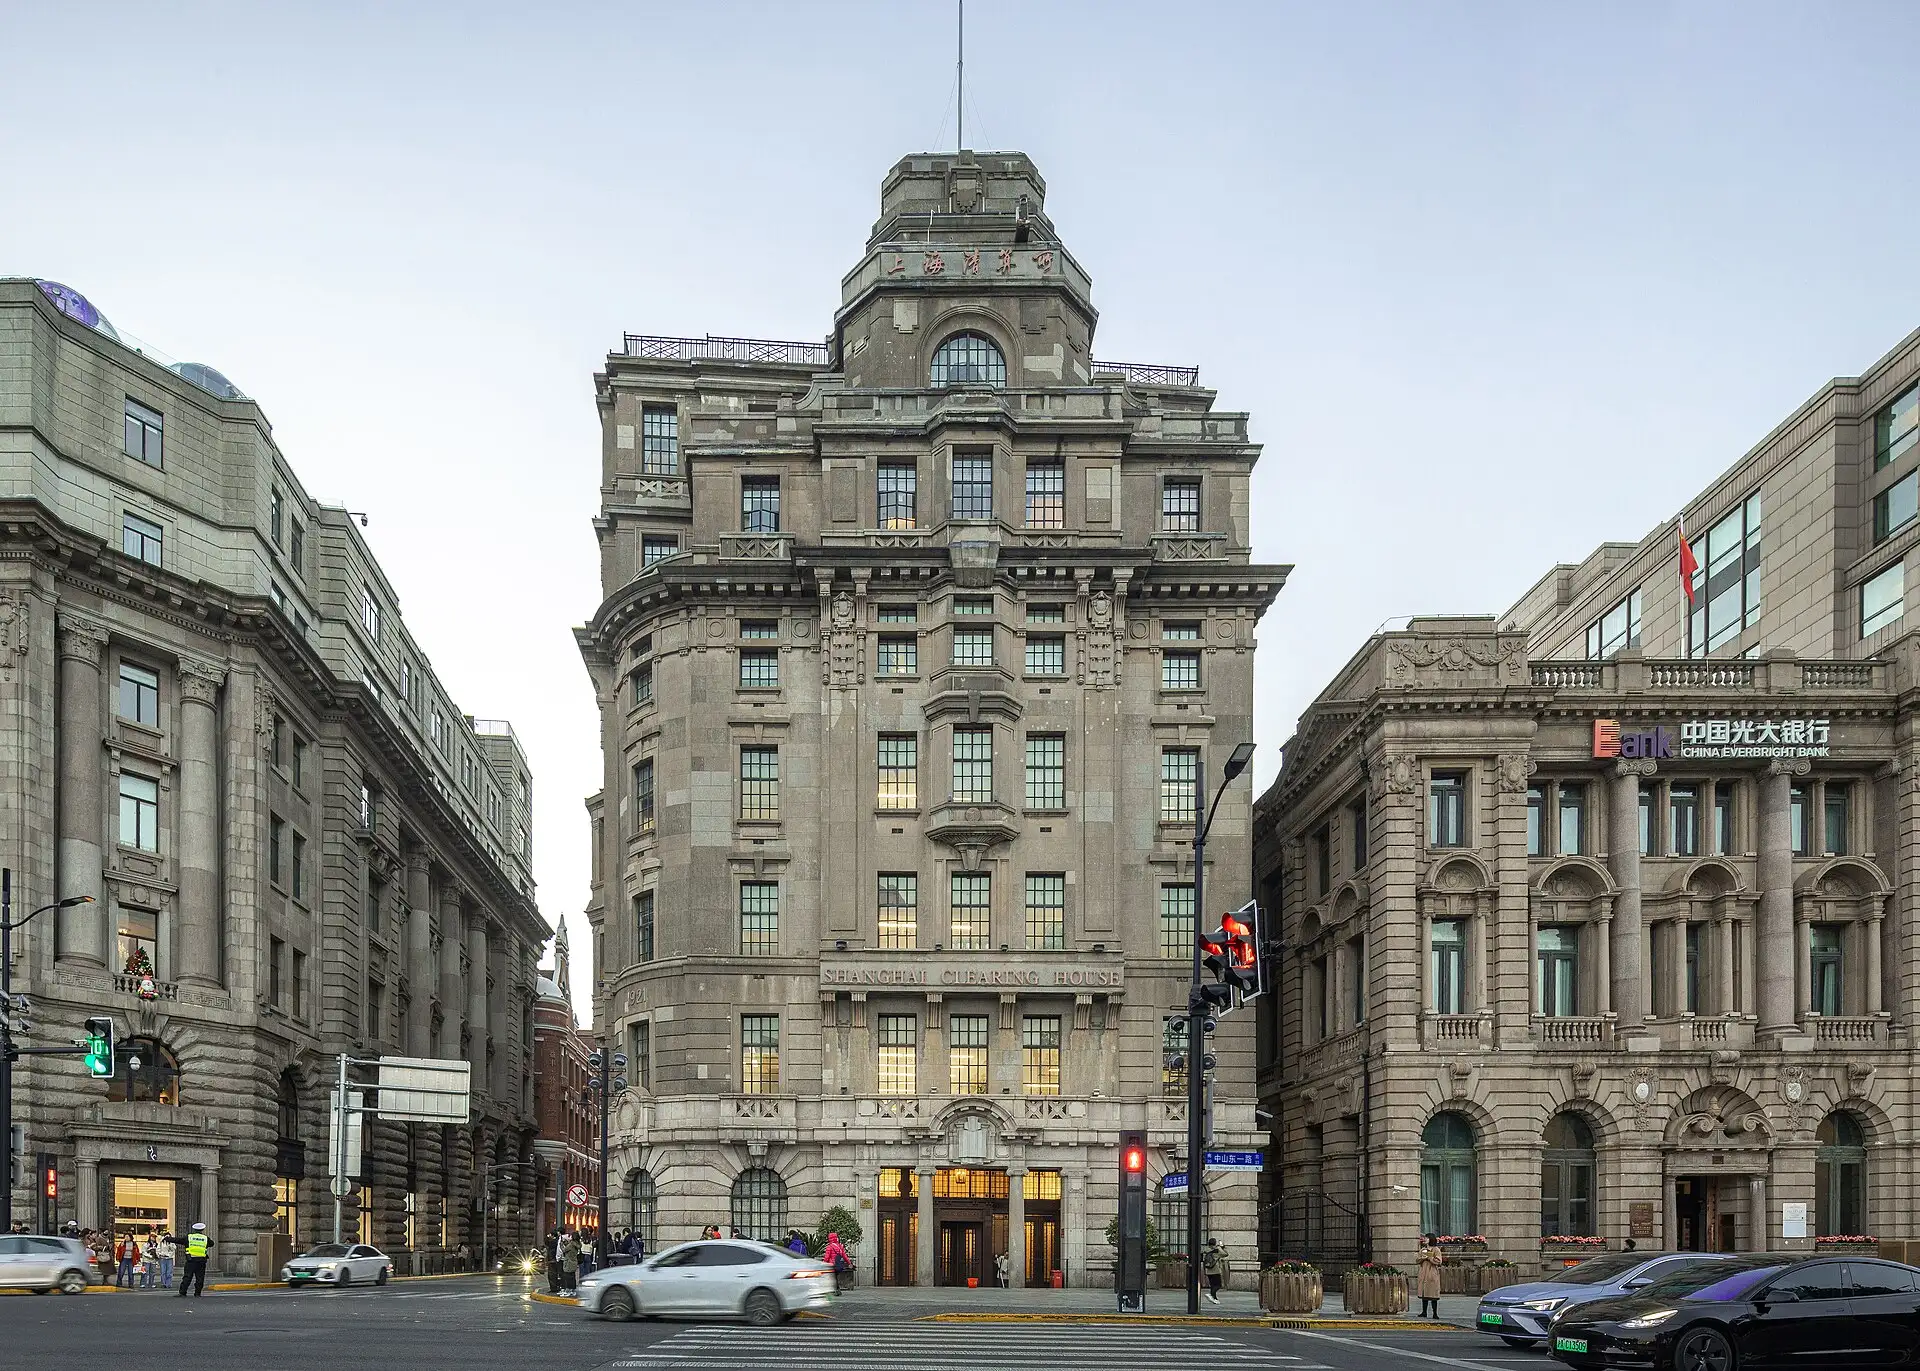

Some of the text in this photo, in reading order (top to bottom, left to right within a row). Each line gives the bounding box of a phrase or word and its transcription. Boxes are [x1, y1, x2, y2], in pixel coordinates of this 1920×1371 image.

[887, 249, 1054, 276] 上海清算所
[1681, 719, 1830, 745] 中国光大银行
[1682, 747, 1830, 758] CHINA EVERBRIGHT BANK
[824, 968, 1121, 986] SHANGHAI CLEARING HOUSE
[1214, 1153, 1252, 1164] 中山东一路
